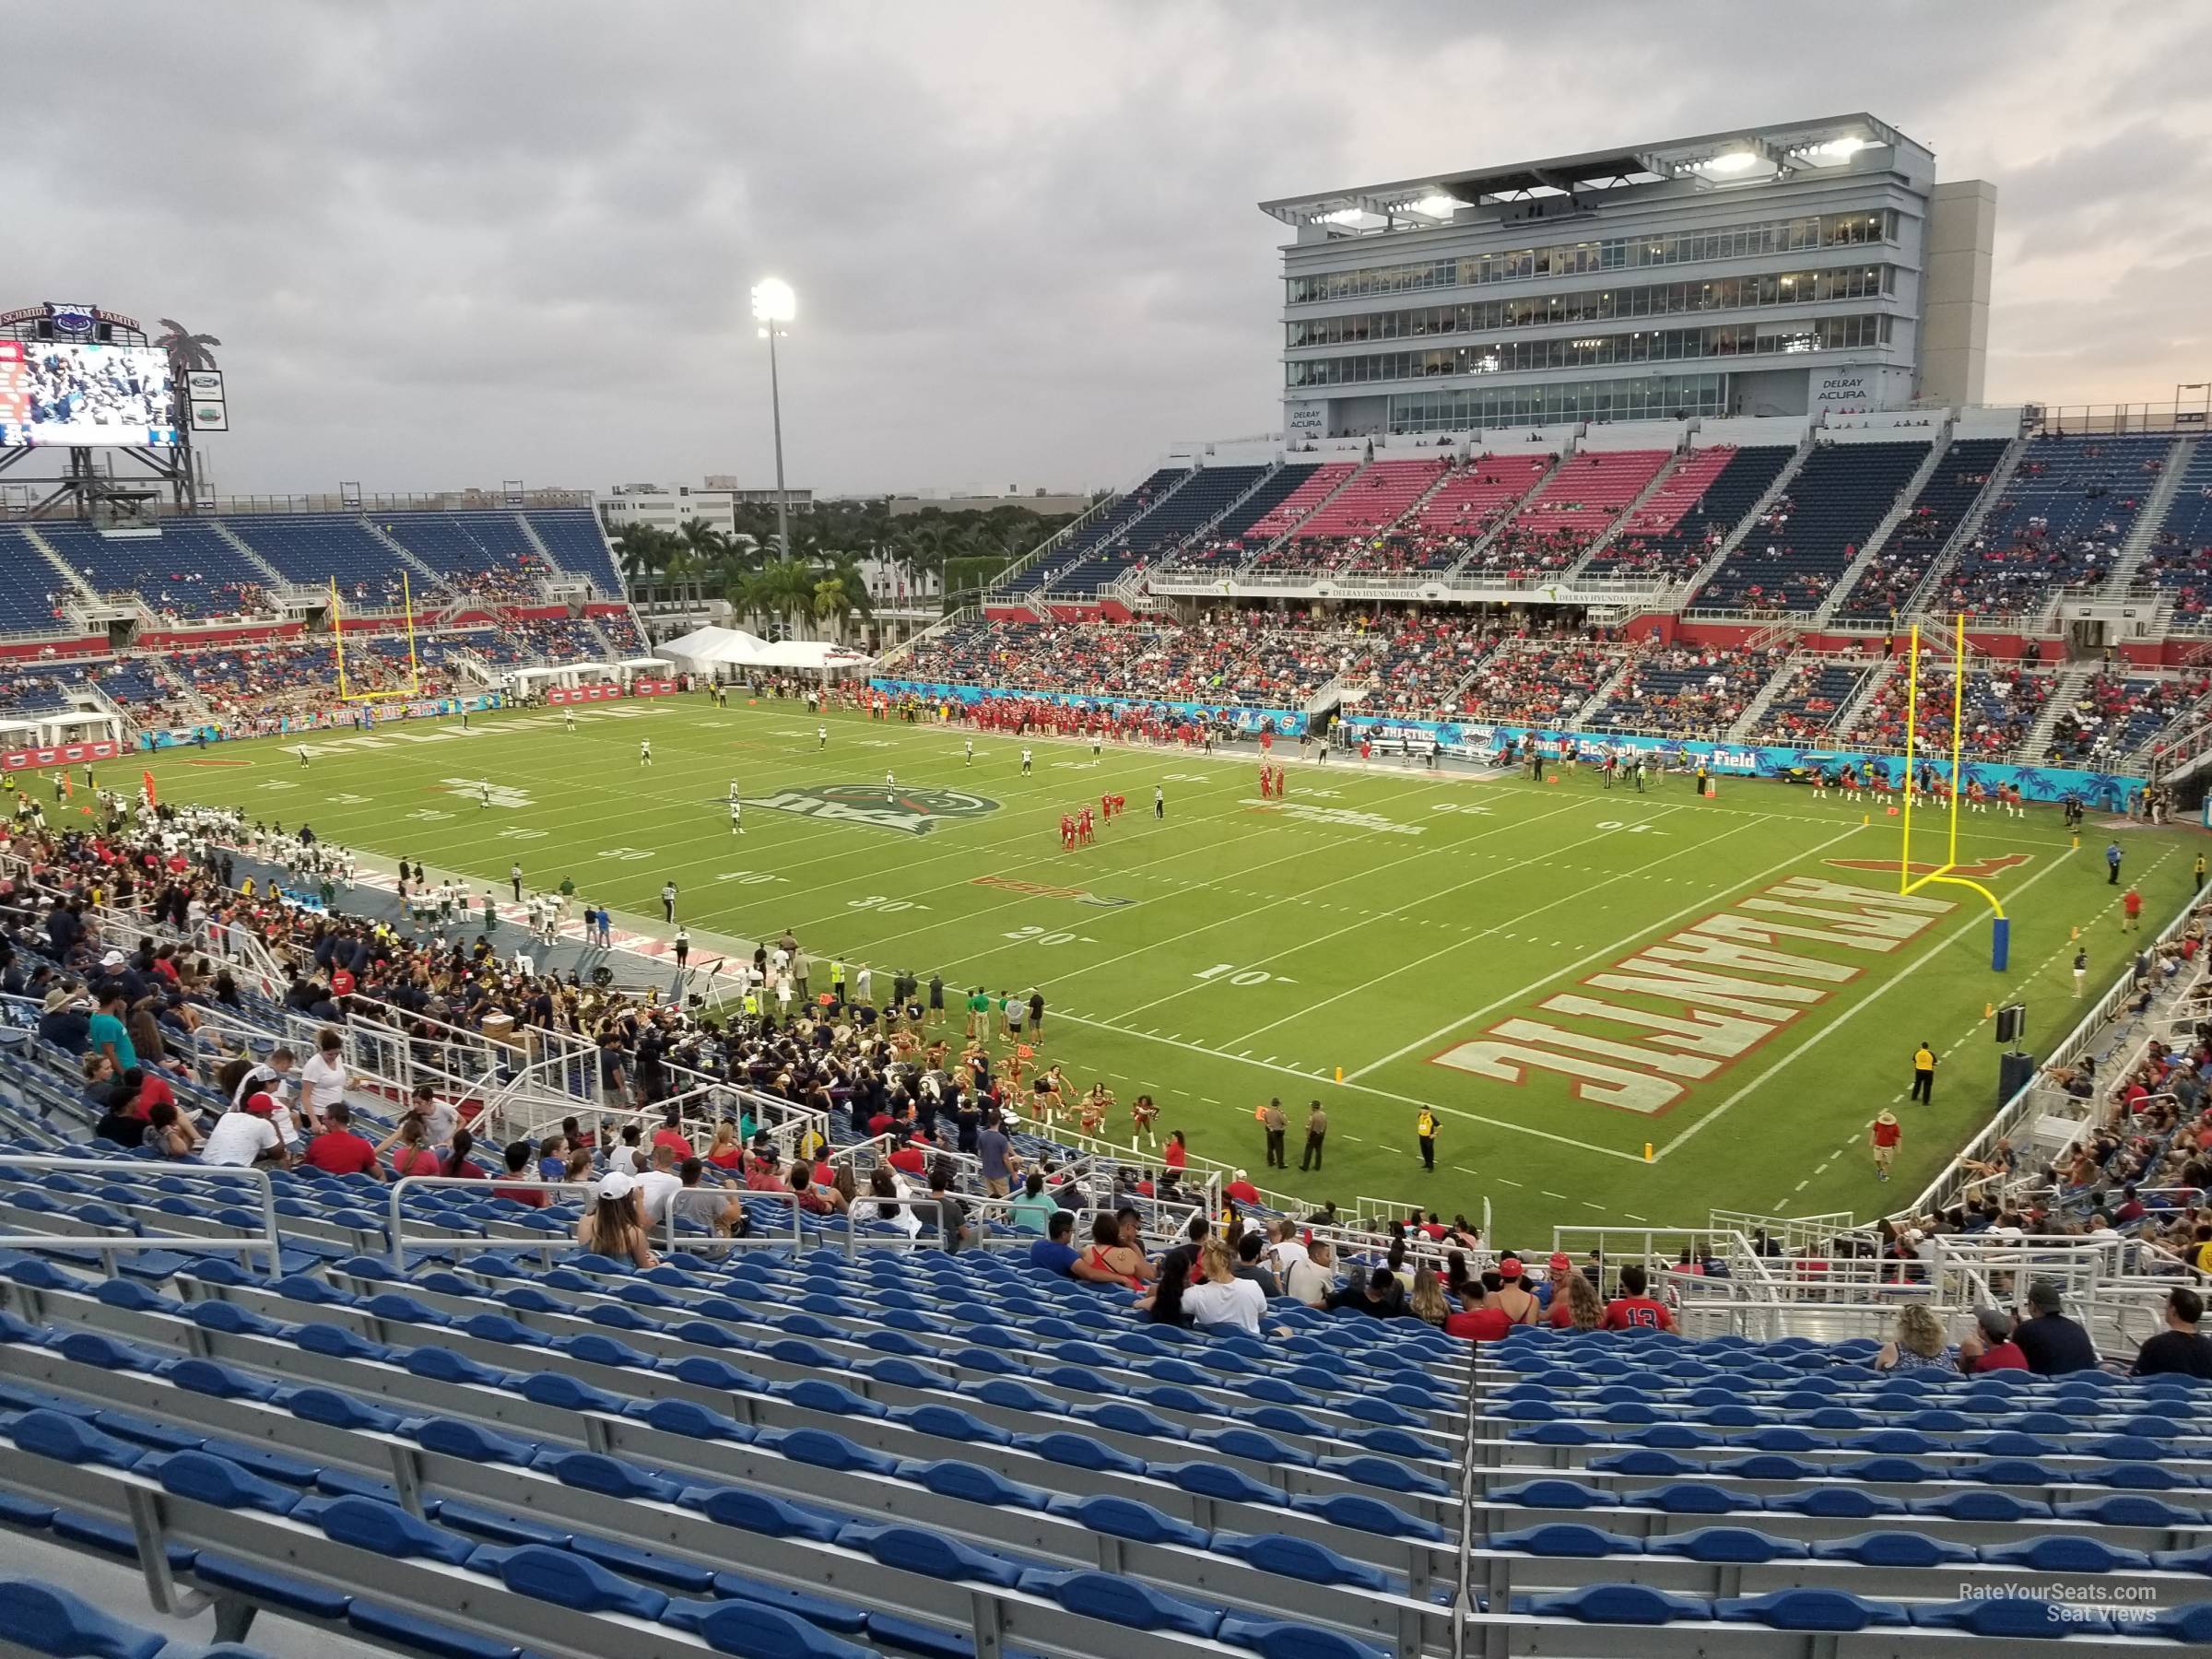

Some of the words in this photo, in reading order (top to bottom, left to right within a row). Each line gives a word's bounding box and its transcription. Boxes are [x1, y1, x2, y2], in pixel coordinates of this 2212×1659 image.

[3, 307, 48, 322] SCHMIDT
[53, 305, 94, 317] FAU
[100, 311, 139, 329] FAMILY
[1823, 378, 1863, 388] DELRAY
[1818, 391, 1866, 400] ACURA
[500, 672, 516, 683] 25
[1462, 725, 1495, 737] FAU
[1713, 750, 1756, 769] Field
[1288, 787, 1343, 798] 30
[596, 847, 656, 860] 50
[714, 870, 776, 885] 40
[846, 896, 914, 912] 30
[1001, 925, 1077, 946] 20
[1192, 963, 1272, 985] 10
[1429, 874, 1961, 1114] ATLANTIC
[1626, 1307, 1659, 1328] 13
